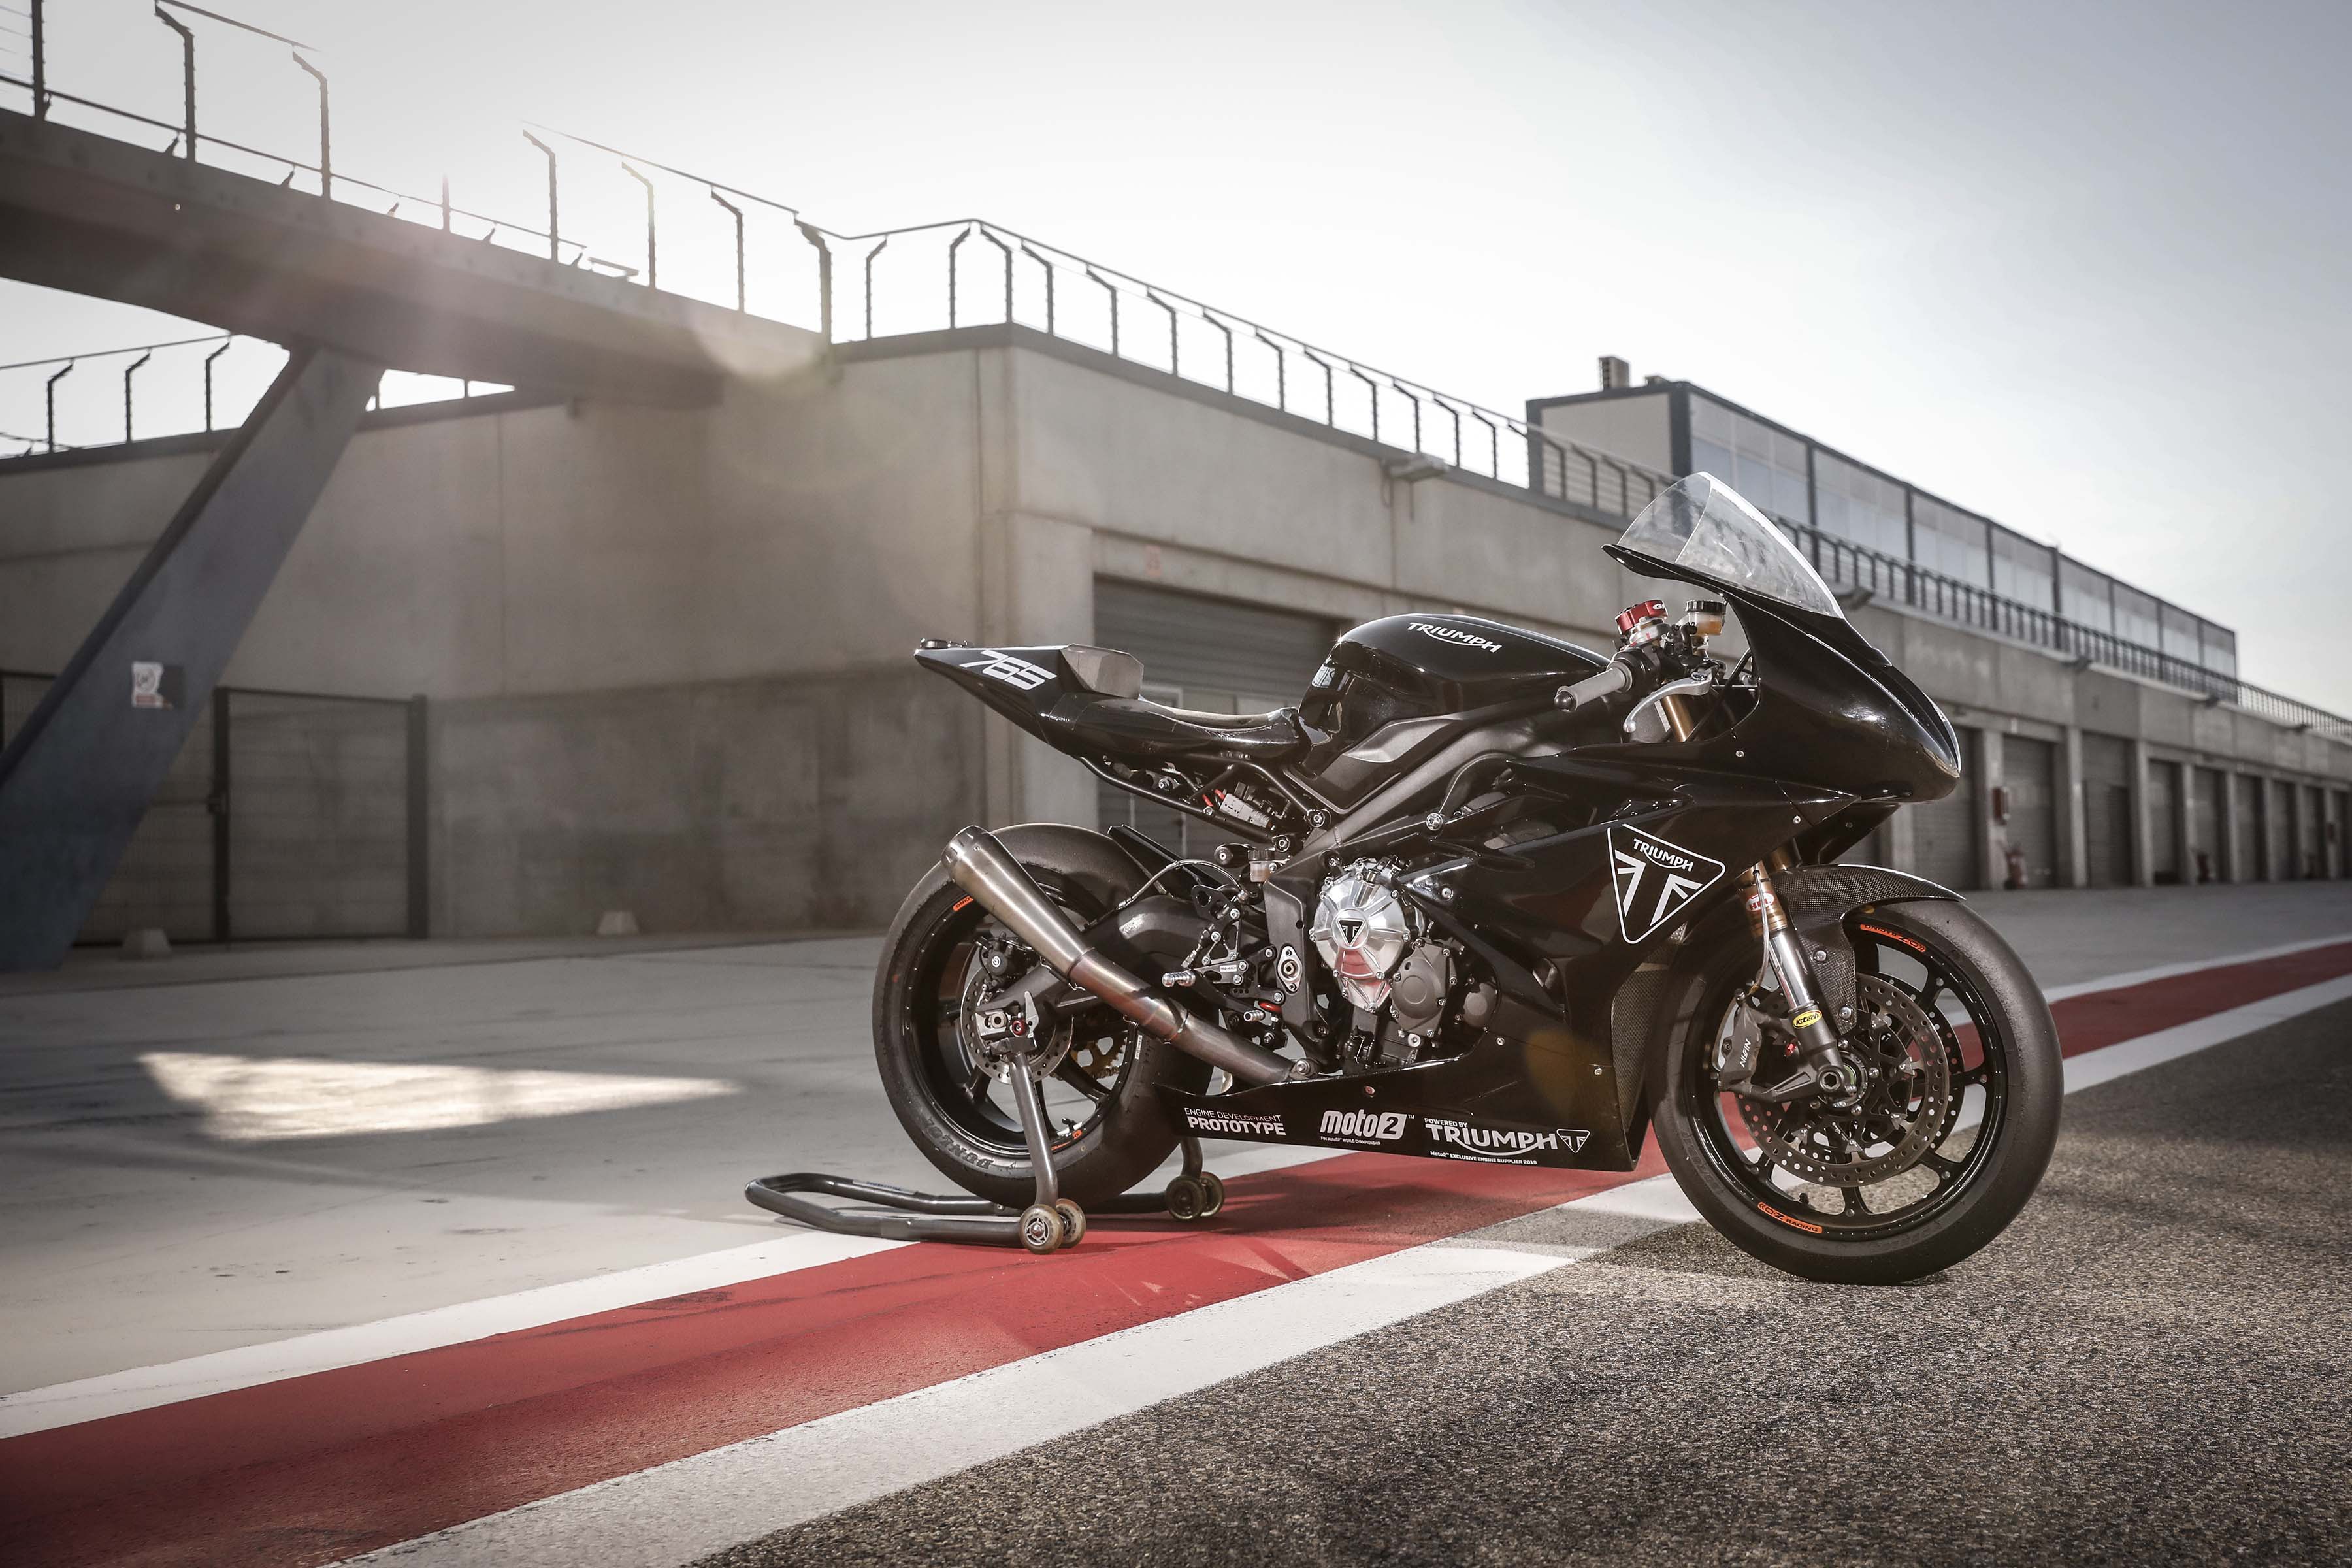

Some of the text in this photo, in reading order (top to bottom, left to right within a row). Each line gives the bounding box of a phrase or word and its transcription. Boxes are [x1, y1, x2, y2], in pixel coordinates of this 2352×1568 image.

[1407, 622, 1503, 653] TRIUMPH
[958, 650, 1058, 691] 765
[1633, 838, 1694, 872] TRIUMPH
[955, 897, 970, 908] CING
[1184, 1107, 1281, 1122] ENGINE DEVELOPMENT
[1186, 1115, 1286, 1135] PROTOTYPE
[1319, 1109, 1407, 1140] moto2
[1424, 1117, 1458, 1127] POWERED
[1425, 1123, 1558, 1156] TRIUMPH
[1786, 1218, 1819, 1232] RACING
